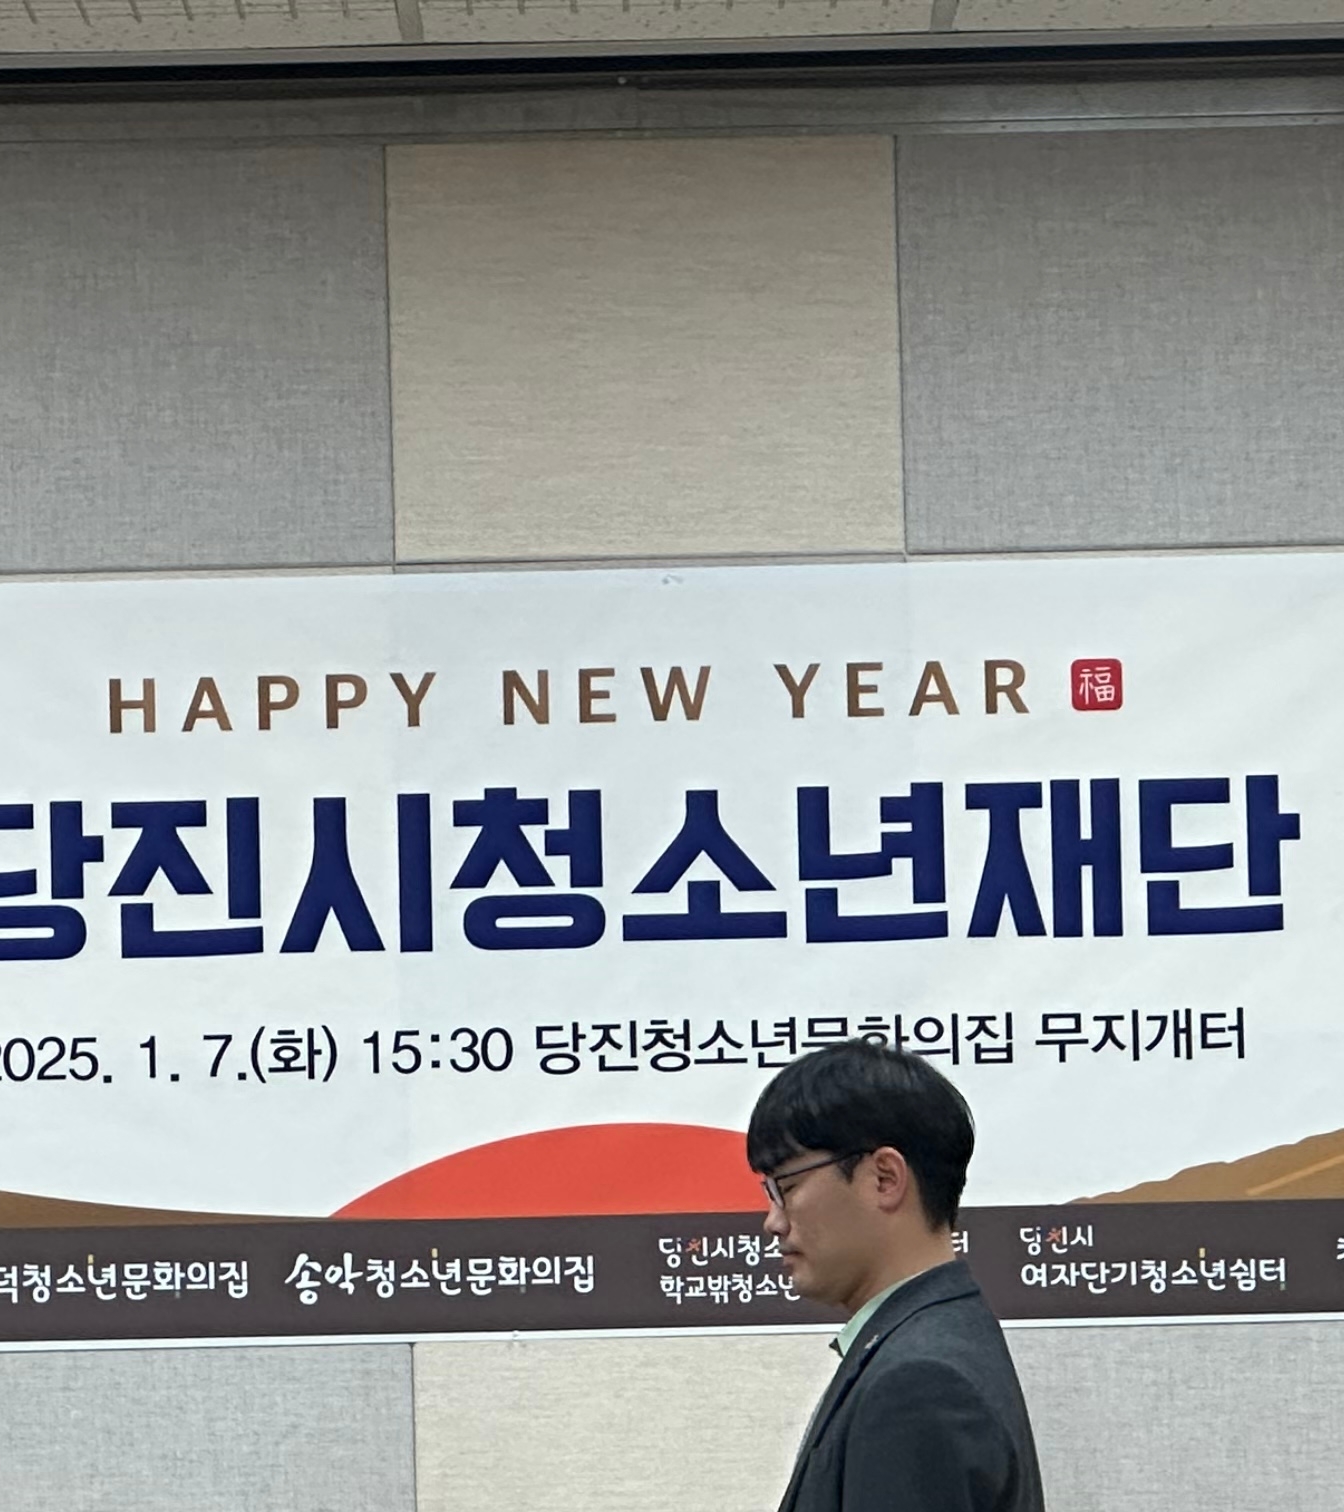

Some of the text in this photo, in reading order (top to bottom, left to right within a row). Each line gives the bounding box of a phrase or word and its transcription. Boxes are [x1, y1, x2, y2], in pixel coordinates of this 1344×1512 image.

[109, 659, 1029, 734] HAPPY NEW YEAR
[1078, 666, 1115, 705] 福
[139, 1035, 180, 1082] 1.
[202, 1024, 338, 1084] 7.(화)
[363, 1027, 514, 1075] 15:30
[1034, 1006, 1245, 1063] 무지개터
[1019, 1224, 1094, 1256] 당진시
[284, 1248, 594, 1305] 송악청소년문화의집
[1020, 1247, 1286, 1295] 여자단기청소년쉼터
